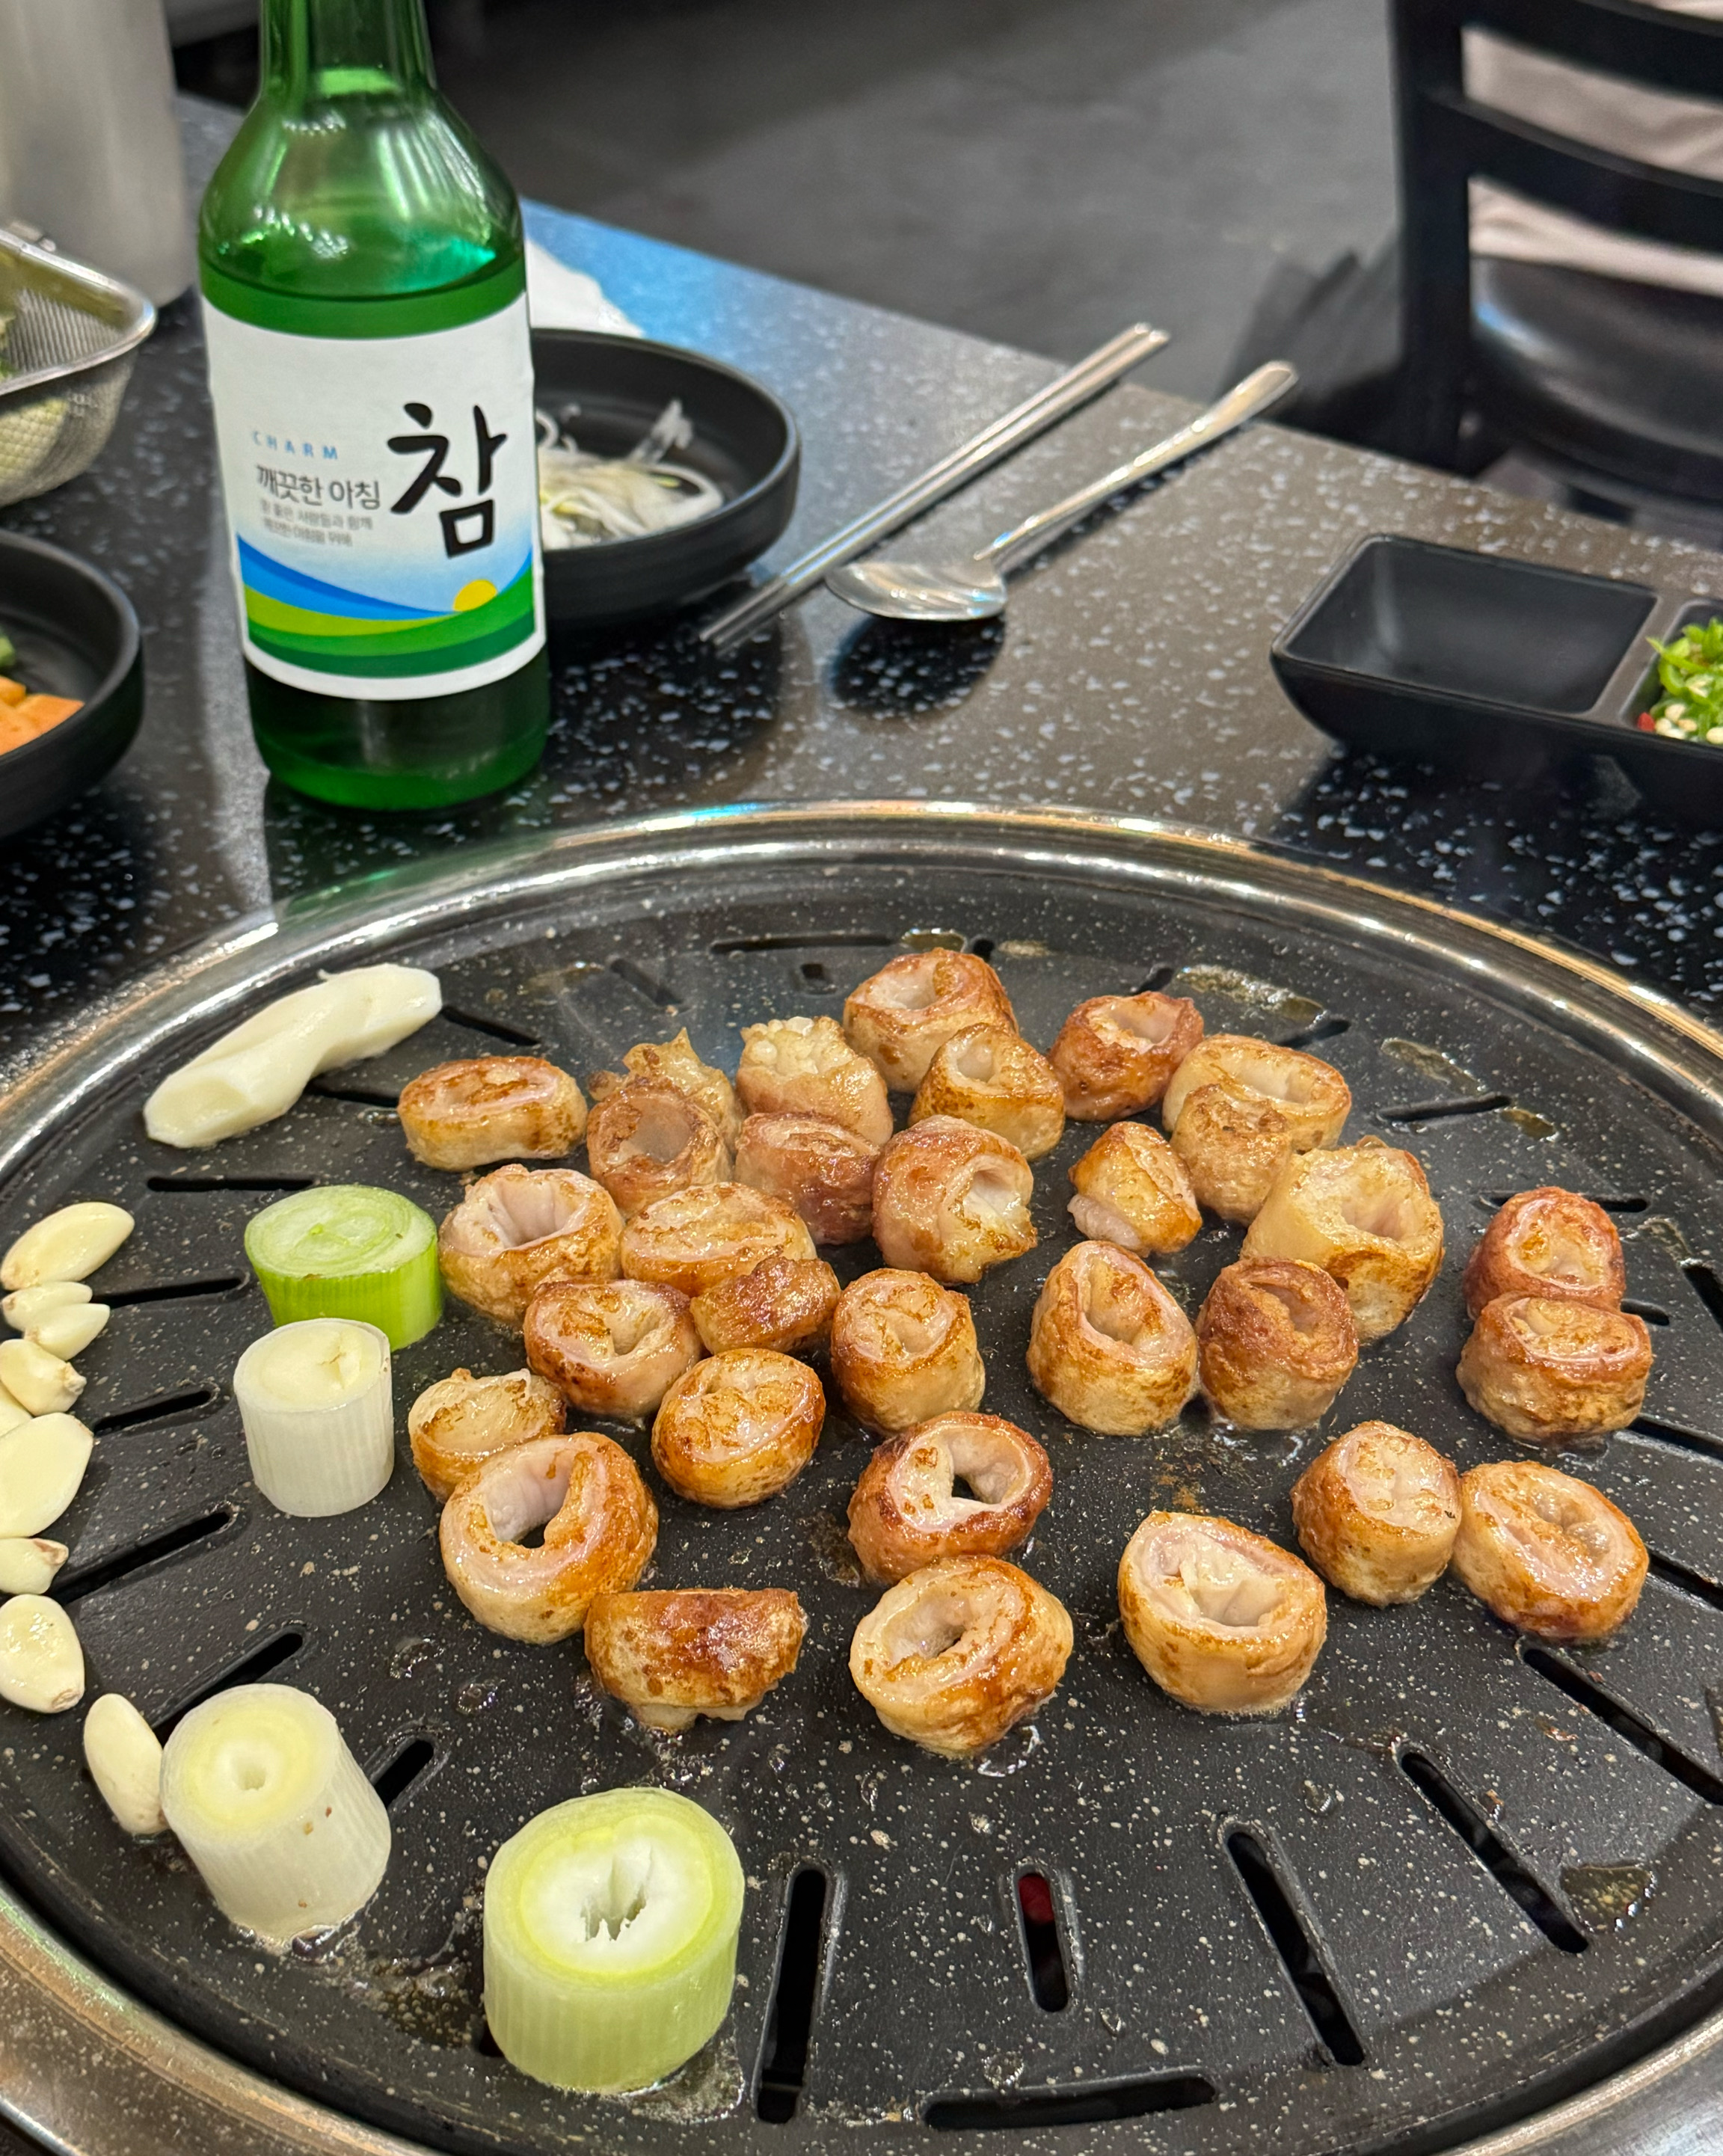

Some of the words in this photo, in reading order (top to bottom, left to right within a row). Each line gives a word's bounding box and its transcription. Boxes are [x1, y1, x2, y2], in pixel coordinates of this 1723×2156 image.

[253, 431, 338, 459] CHARM
[257, 465, 323, 506] 깨끗한
[329, 478, 380, 510] 아침
[387, 402, 508, 559] 참
